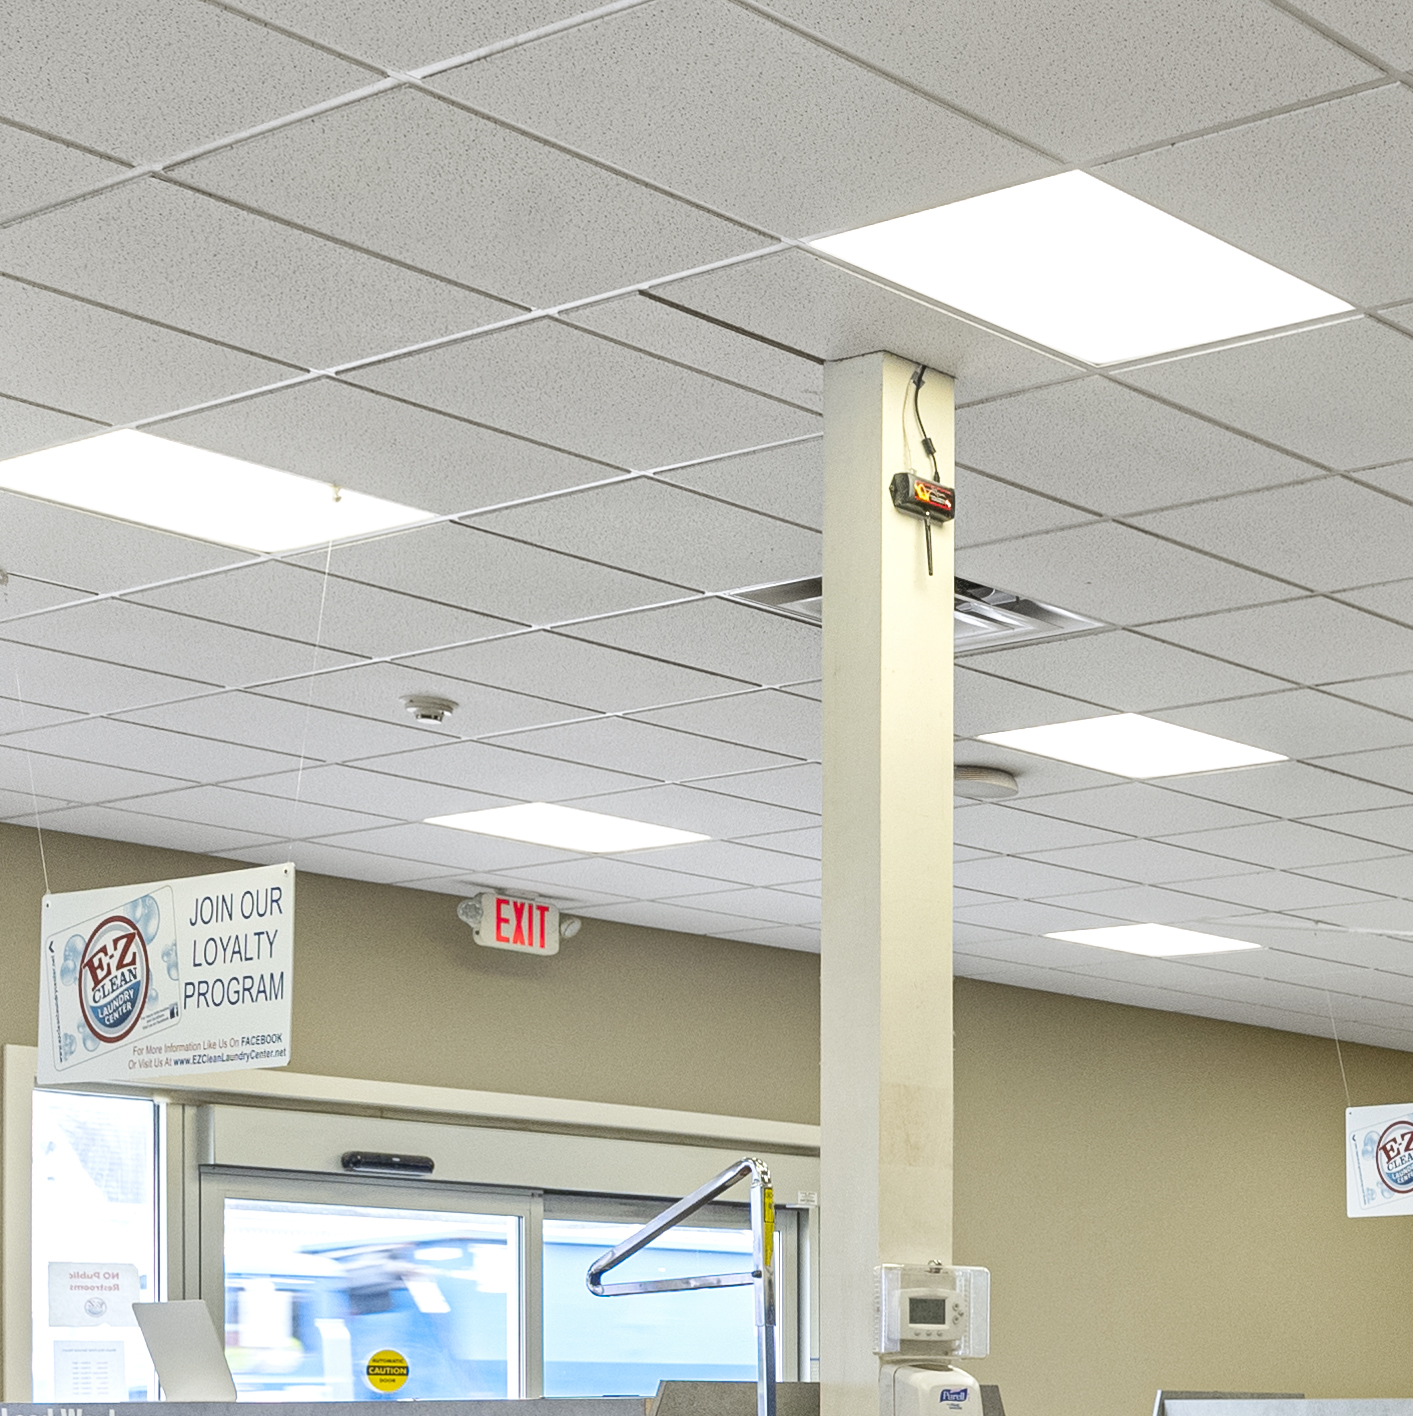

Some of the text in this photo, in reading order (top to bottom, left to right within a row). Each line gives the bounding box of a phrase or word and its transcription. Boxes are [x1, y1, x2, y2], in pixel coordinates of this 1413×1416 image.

[189, 886, 283, 926] JOIN OUR
[495, 897, 549, 949] EXIT
[193, 929, 278, 967] LOYALTY
[92, 966, 137, 1003] CLEAN
[98, 988, 135, 1018] LAUNDRY
[184, 971, 284, 1010] PROGRAM
[104, 1002, 132, 1025] CENTER
[203, 1040, 217, 1050] Like
[218, 1040, 227, 1049] Us
[229, 1038, 239, 1048] On
[241, 1033, 282, 1046] FACEBOOK
[368, 1367, 407, 1375] CAUTION
